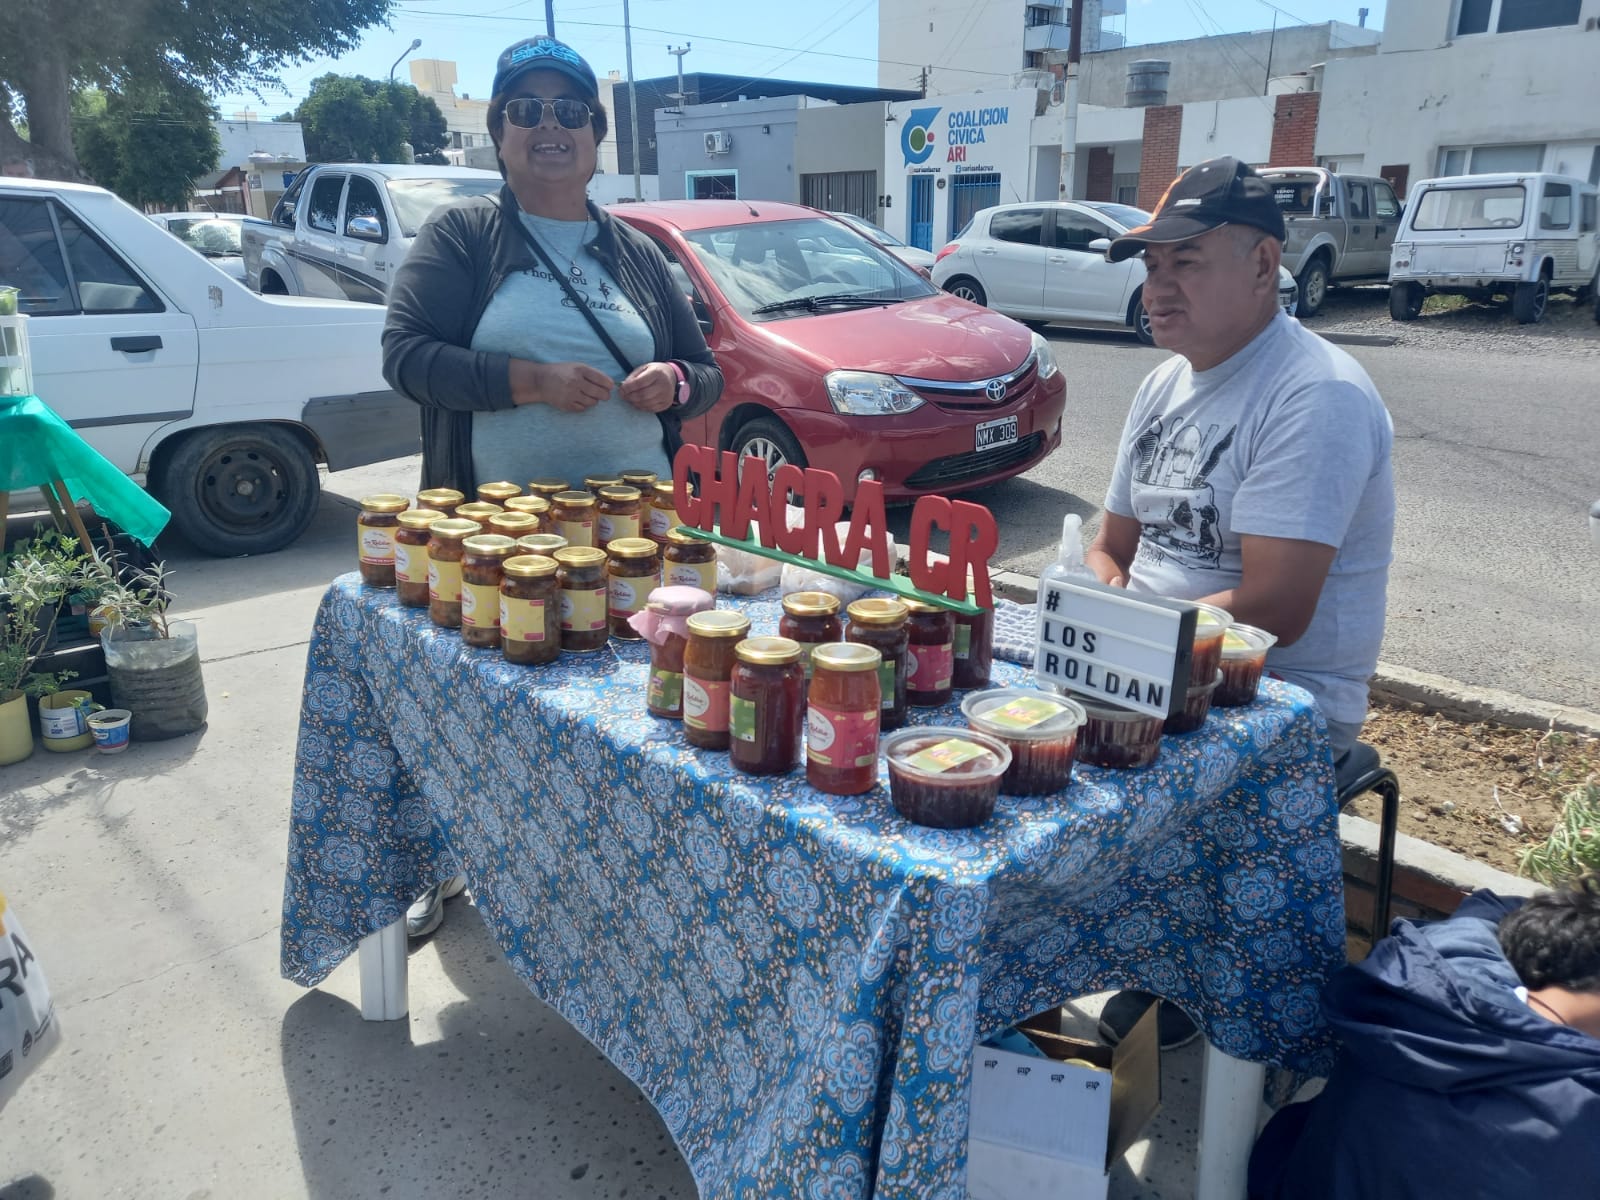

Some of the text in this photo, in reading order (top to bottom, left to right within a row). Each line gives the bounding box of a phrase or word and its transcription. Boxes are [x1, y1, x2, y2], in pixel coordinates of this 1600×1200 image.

[948, 107, 1008, 128] COALICION
[948, 127, 986, 145] CIVICA
[946, 146, 967, 163] ARI
[532, 269, 556, 283] hop
[977, 423, 1017, 446] NMX 309
[672, 444, 999, 610] CHACRA CR
[1045, 590, 1061, 612] #
[1044, 621, 1097, 653] LOS
[1045, 652, 1164, 707] ROLDAN
